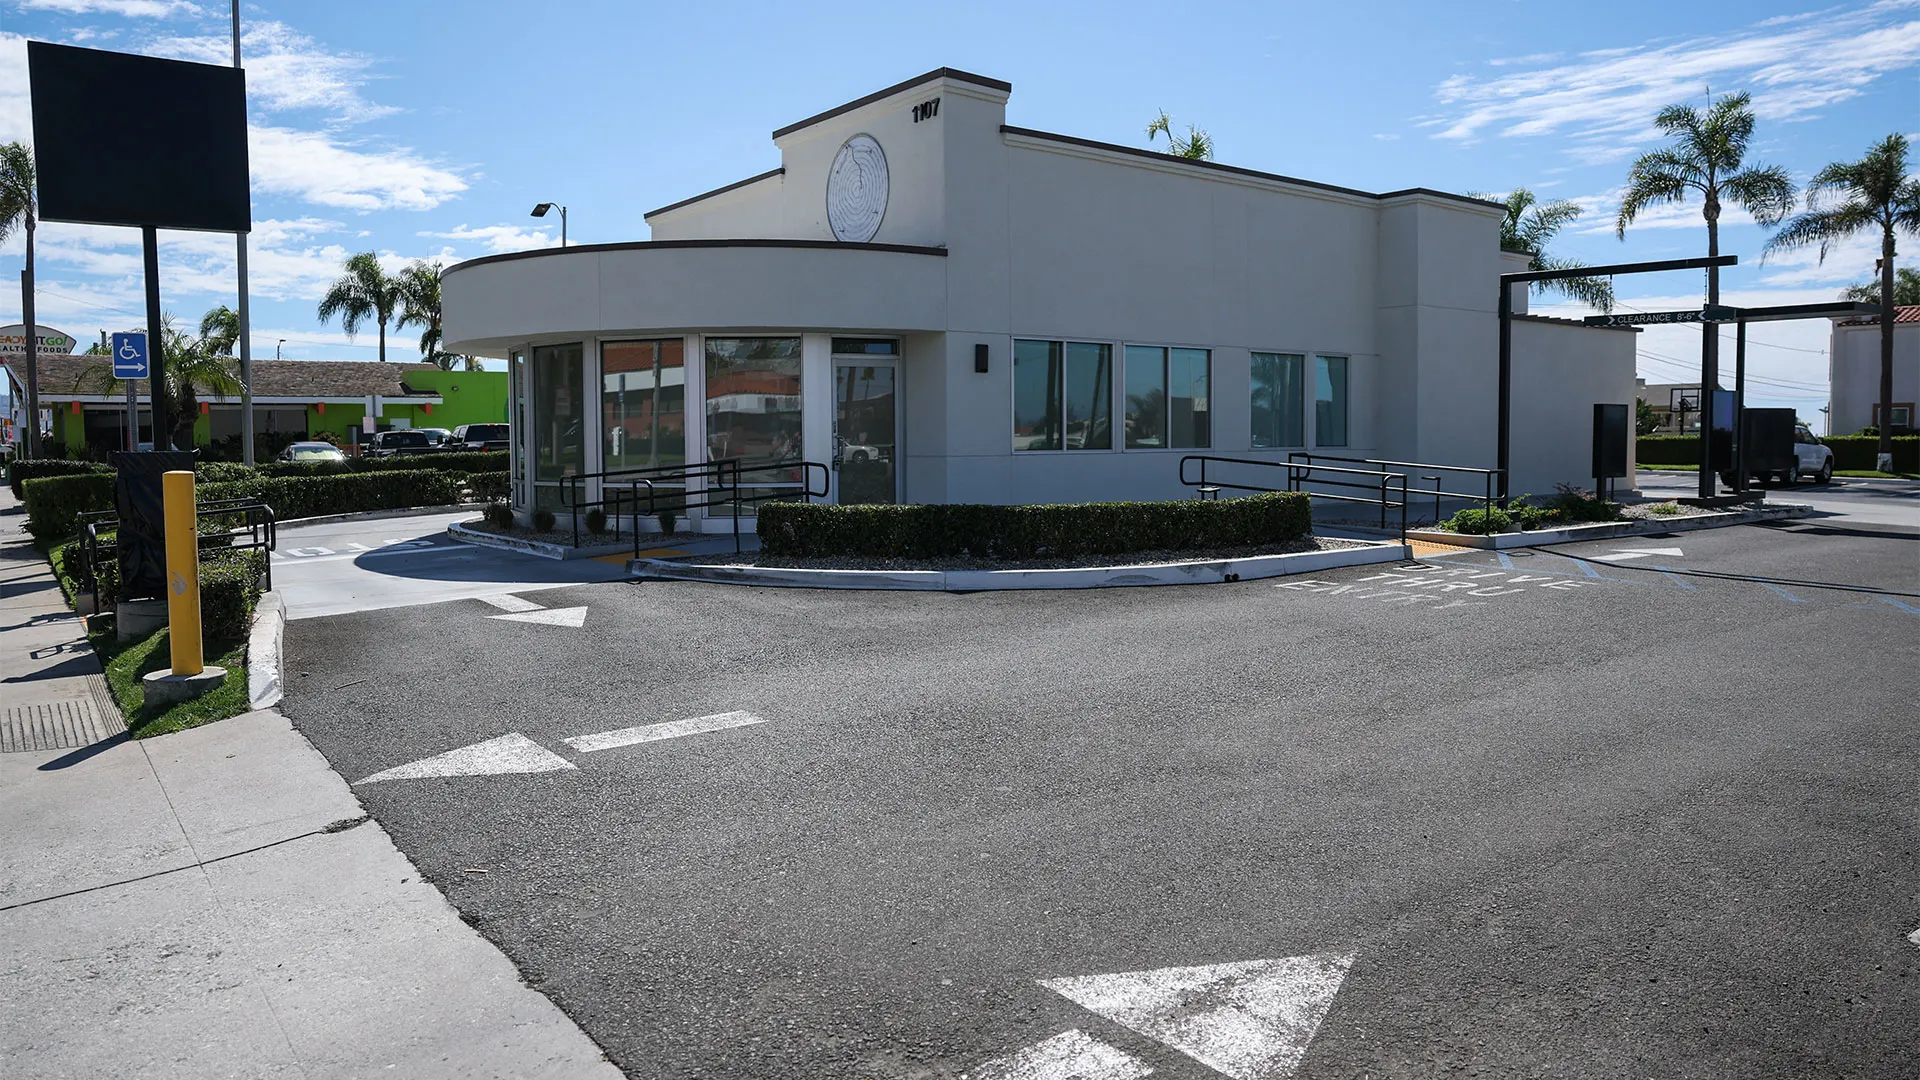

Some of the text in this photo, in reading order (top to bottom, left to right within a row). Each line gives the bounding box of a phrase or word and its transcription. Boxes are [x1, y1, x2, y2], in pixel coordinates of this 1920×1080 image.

[912, 97, 940, 123] 1107
[1617, 313, 1671, 324] CLEARANCE
[1356, 572, 1525, 597] THRU
[1393, 563, 1598, 590] DRIVE
[1274, 580, 1487, 609] ENTRY
